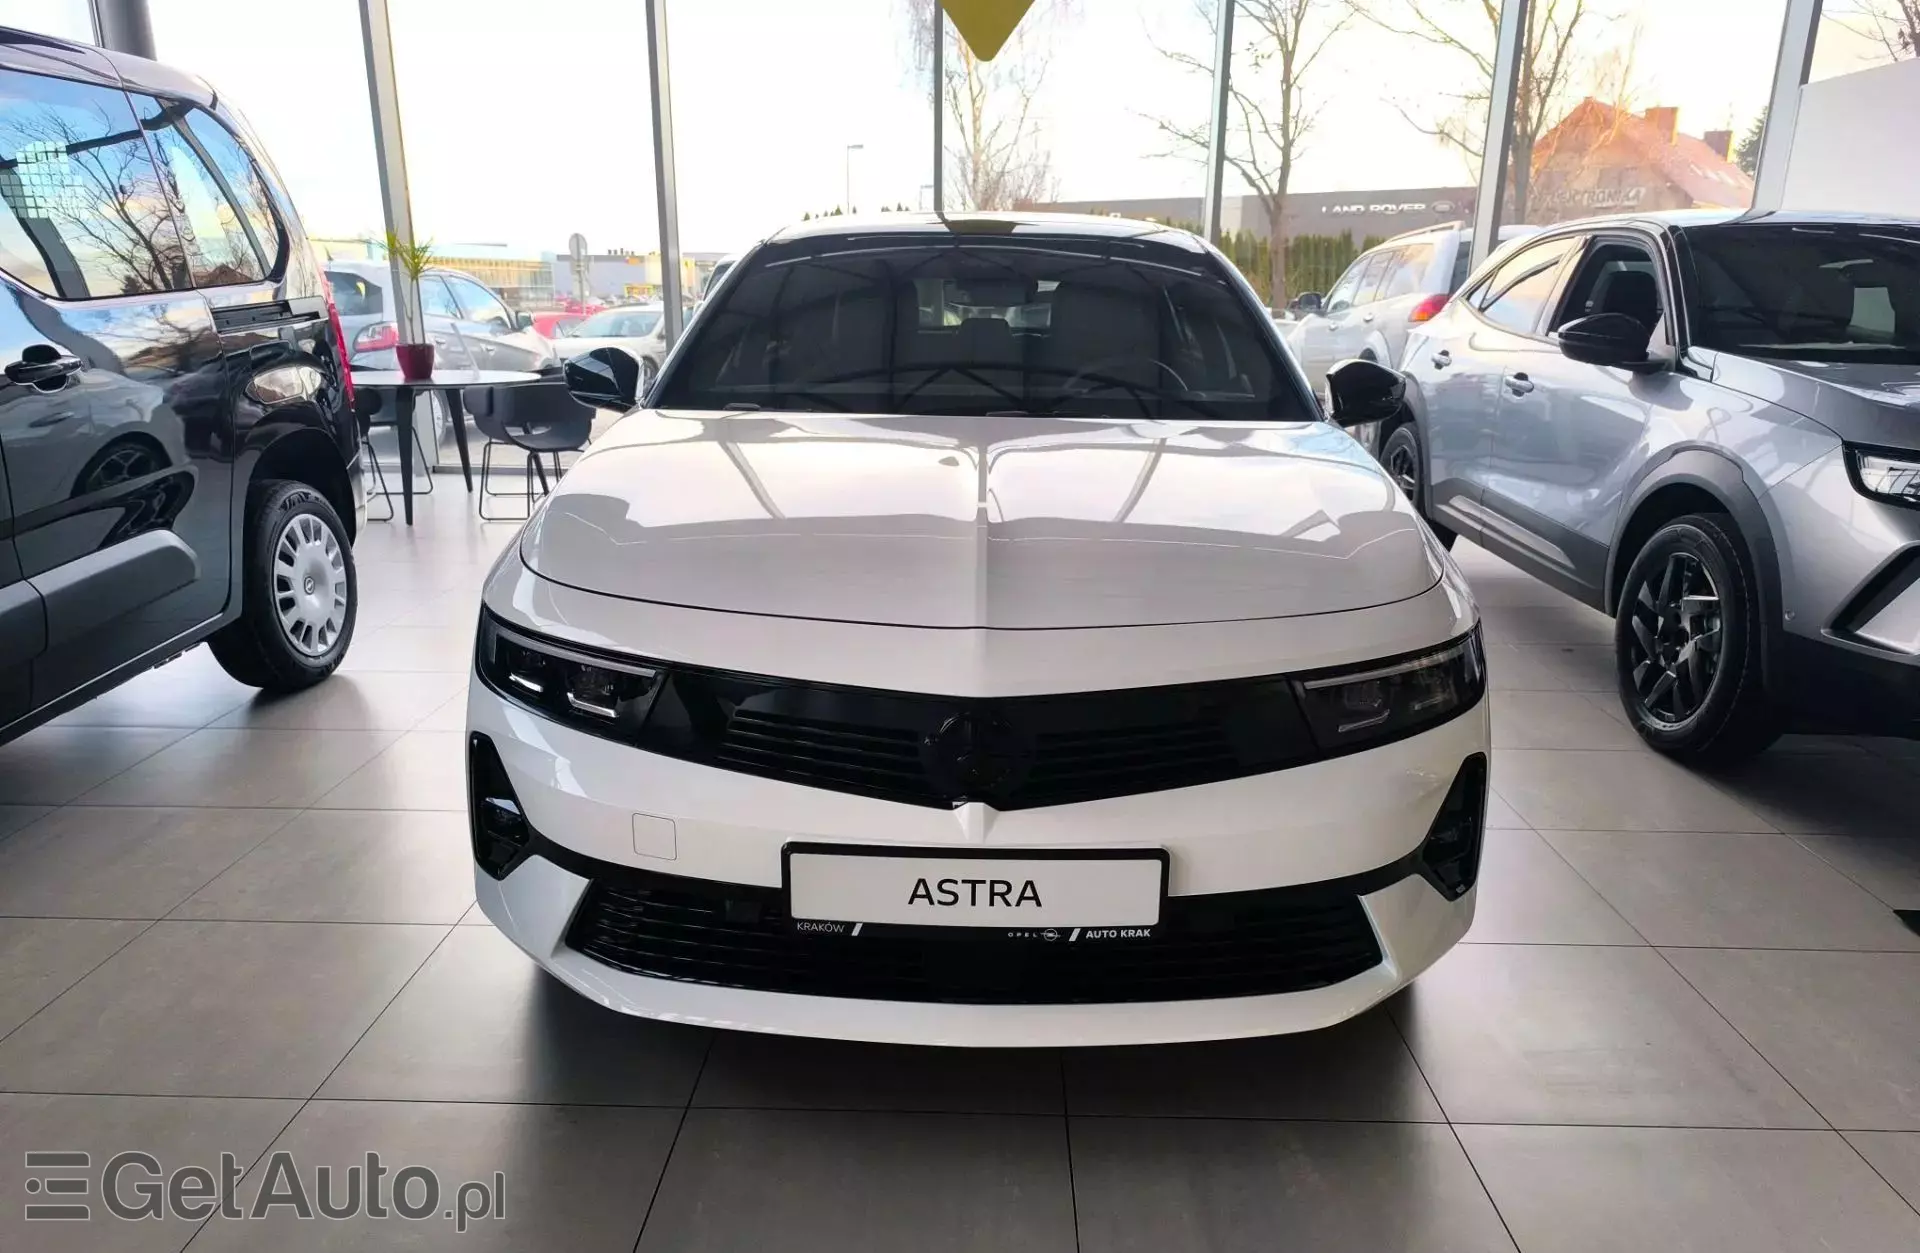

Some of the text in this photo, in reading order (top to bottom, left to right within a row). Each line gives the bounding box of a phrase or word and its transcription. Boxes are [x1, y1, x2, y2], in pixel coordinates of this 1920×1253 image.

[1368, 202, 1427, 215] ROVER
[907, 877, 1043, 908] ASTRA
[796, 921, 846, 933] KRAKÓW
[1085, 929, 1118, 939] AUTO
[1120, 928, 1151, 938] KRAK
